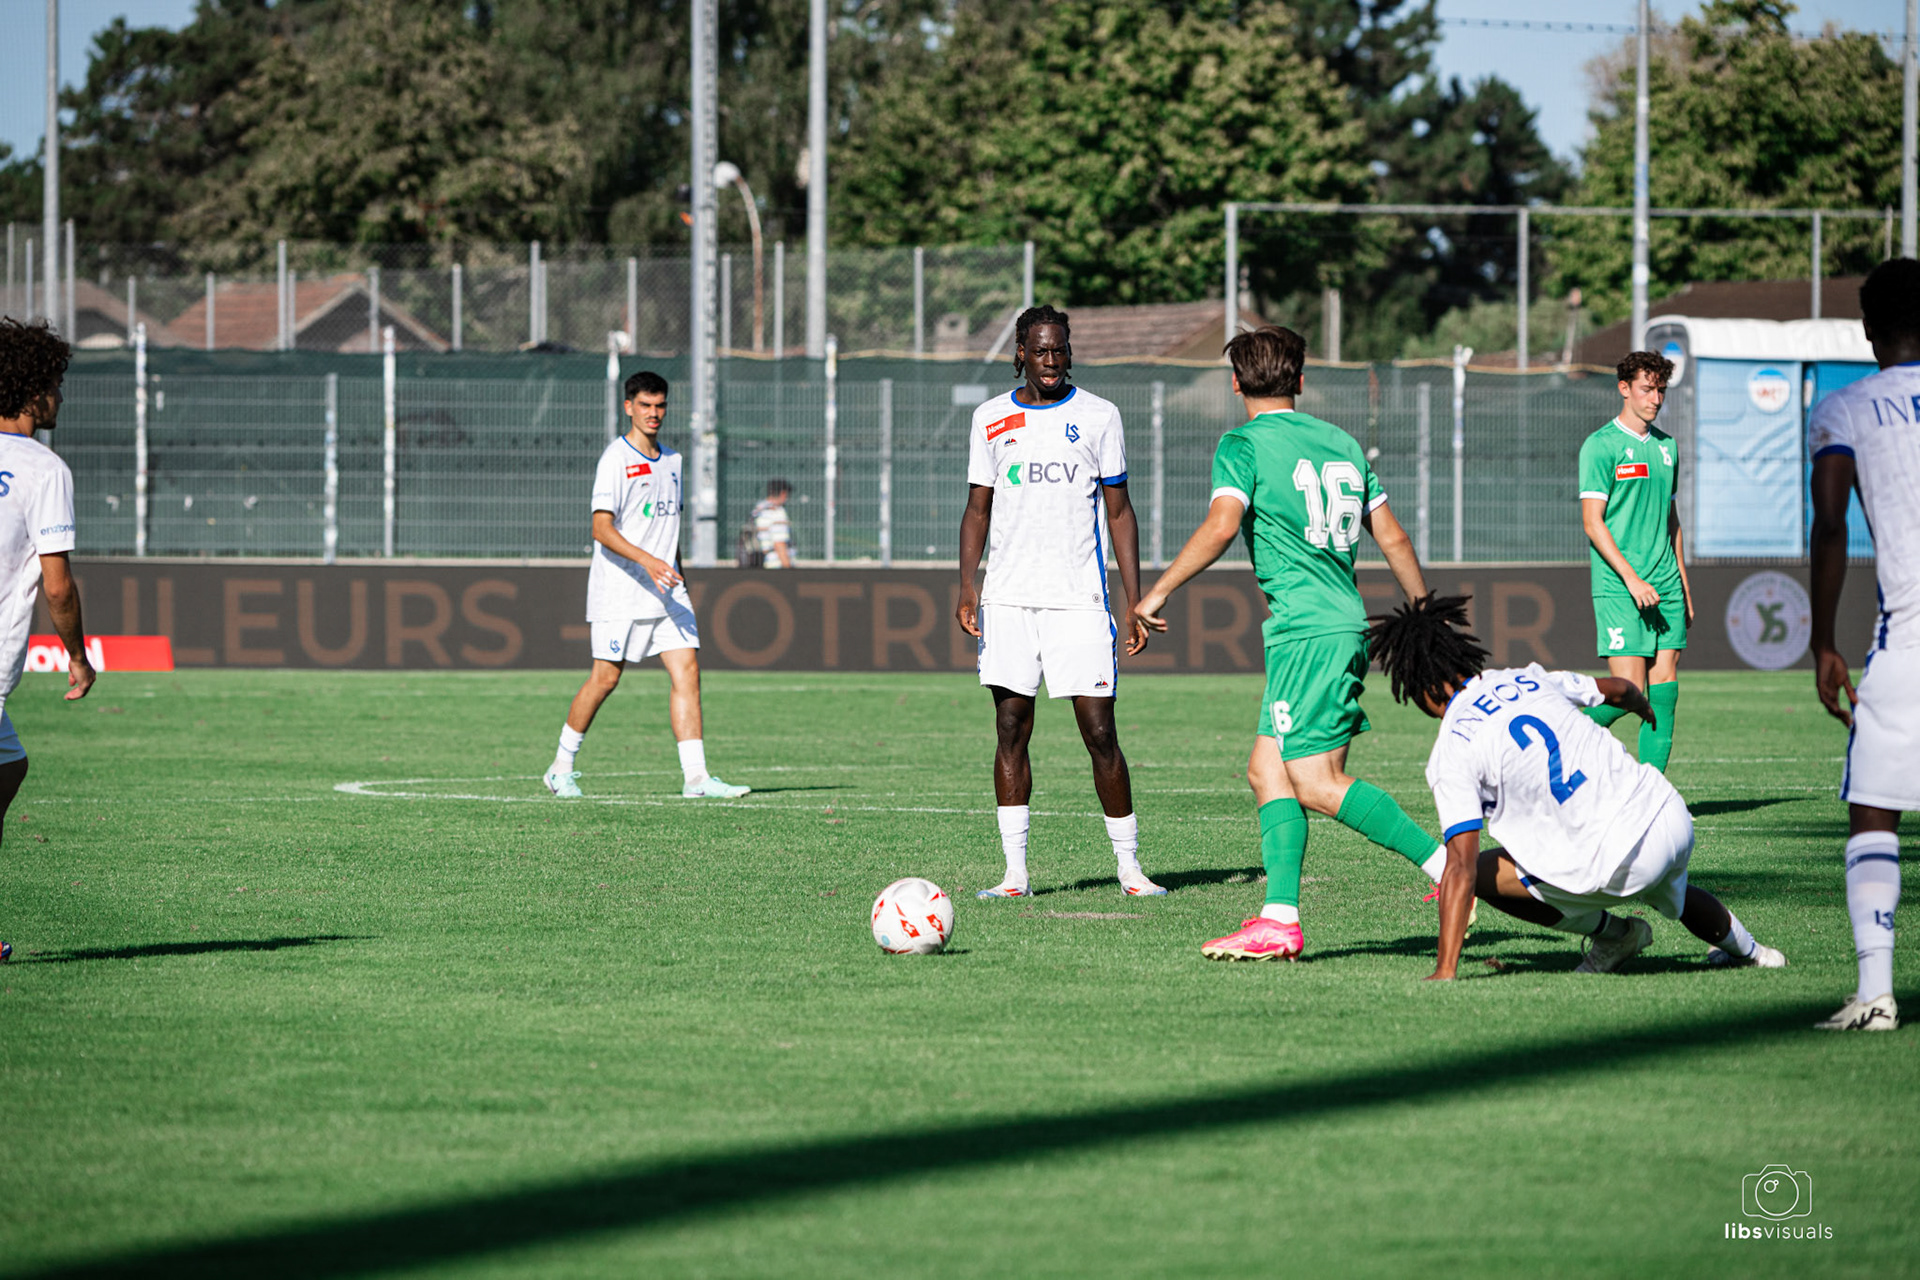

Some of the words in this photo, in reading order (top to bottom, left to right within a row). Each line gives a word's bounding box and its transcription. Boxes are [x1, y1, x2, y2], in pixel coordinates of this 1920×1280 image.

[1028, 462, 1080, 484] BCV
[1292, 458, 1365, 552] 16
[689, 580, 979, 668] OTR
[1451, 675, 1540, 743] INEOS
[1508, 714, 1588, 806] 2
